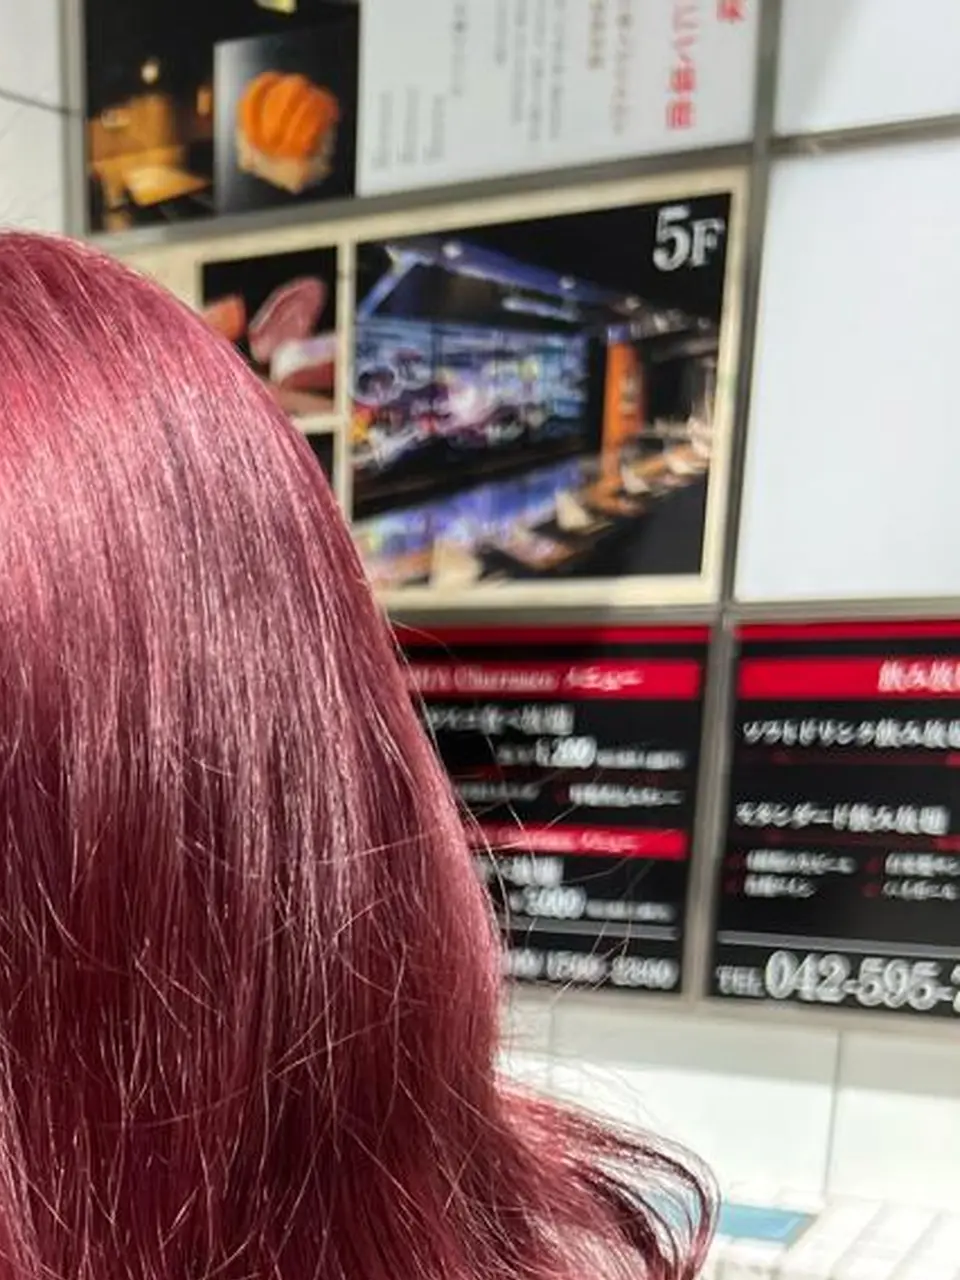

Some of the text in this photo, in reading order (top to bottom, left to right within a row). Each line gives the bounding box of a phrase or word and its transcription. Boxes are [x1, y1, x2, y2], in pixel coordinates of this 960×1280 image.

[653, 204, 726, 272] 5F
[878, 660, 960, 693] 飲み放
